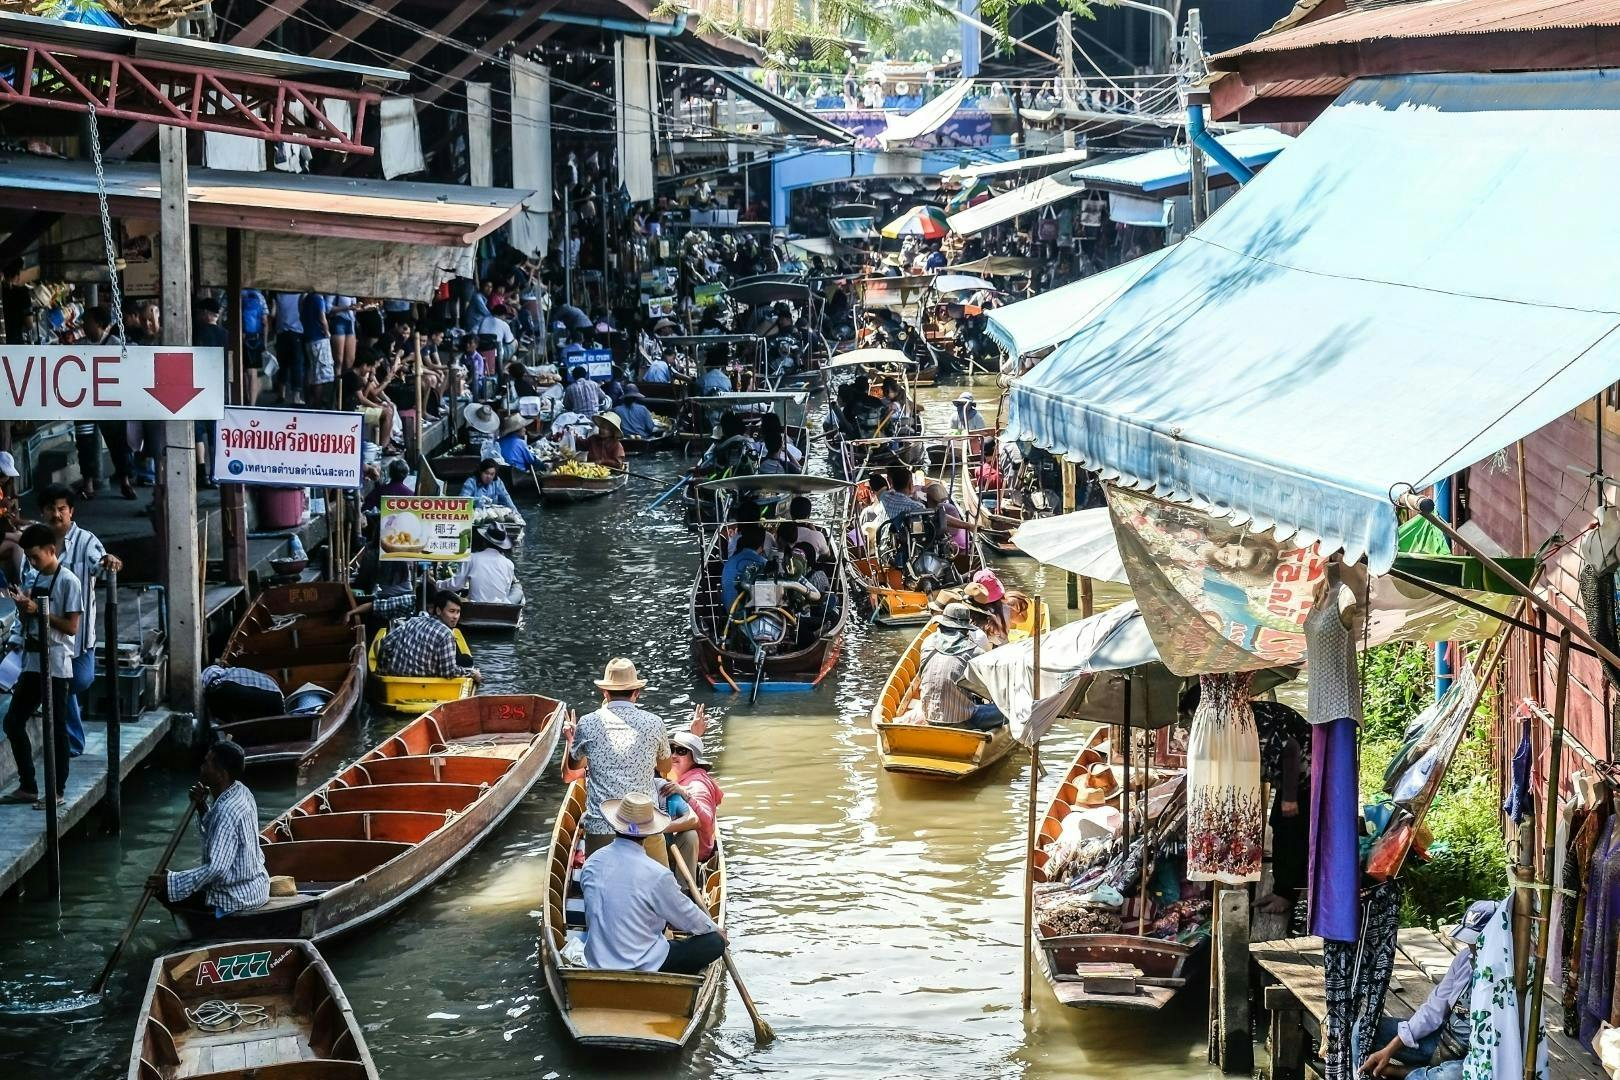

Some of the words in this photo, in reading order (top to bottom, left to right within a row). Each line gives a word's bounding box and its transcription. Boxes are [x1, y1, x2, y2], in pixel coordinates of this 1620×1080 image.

[2, 355, 122, 408] VICE
[221, 417, 358, 457] จุดดับเครื่องยนต์
[245, 462, 355, 478] เทศบาลตำบลดำเนินสะดวก
[387, 499, 468, 510] COCONUT
[435, 524, 456, 534] 椰子
[196, 951, 272, 986] A777
